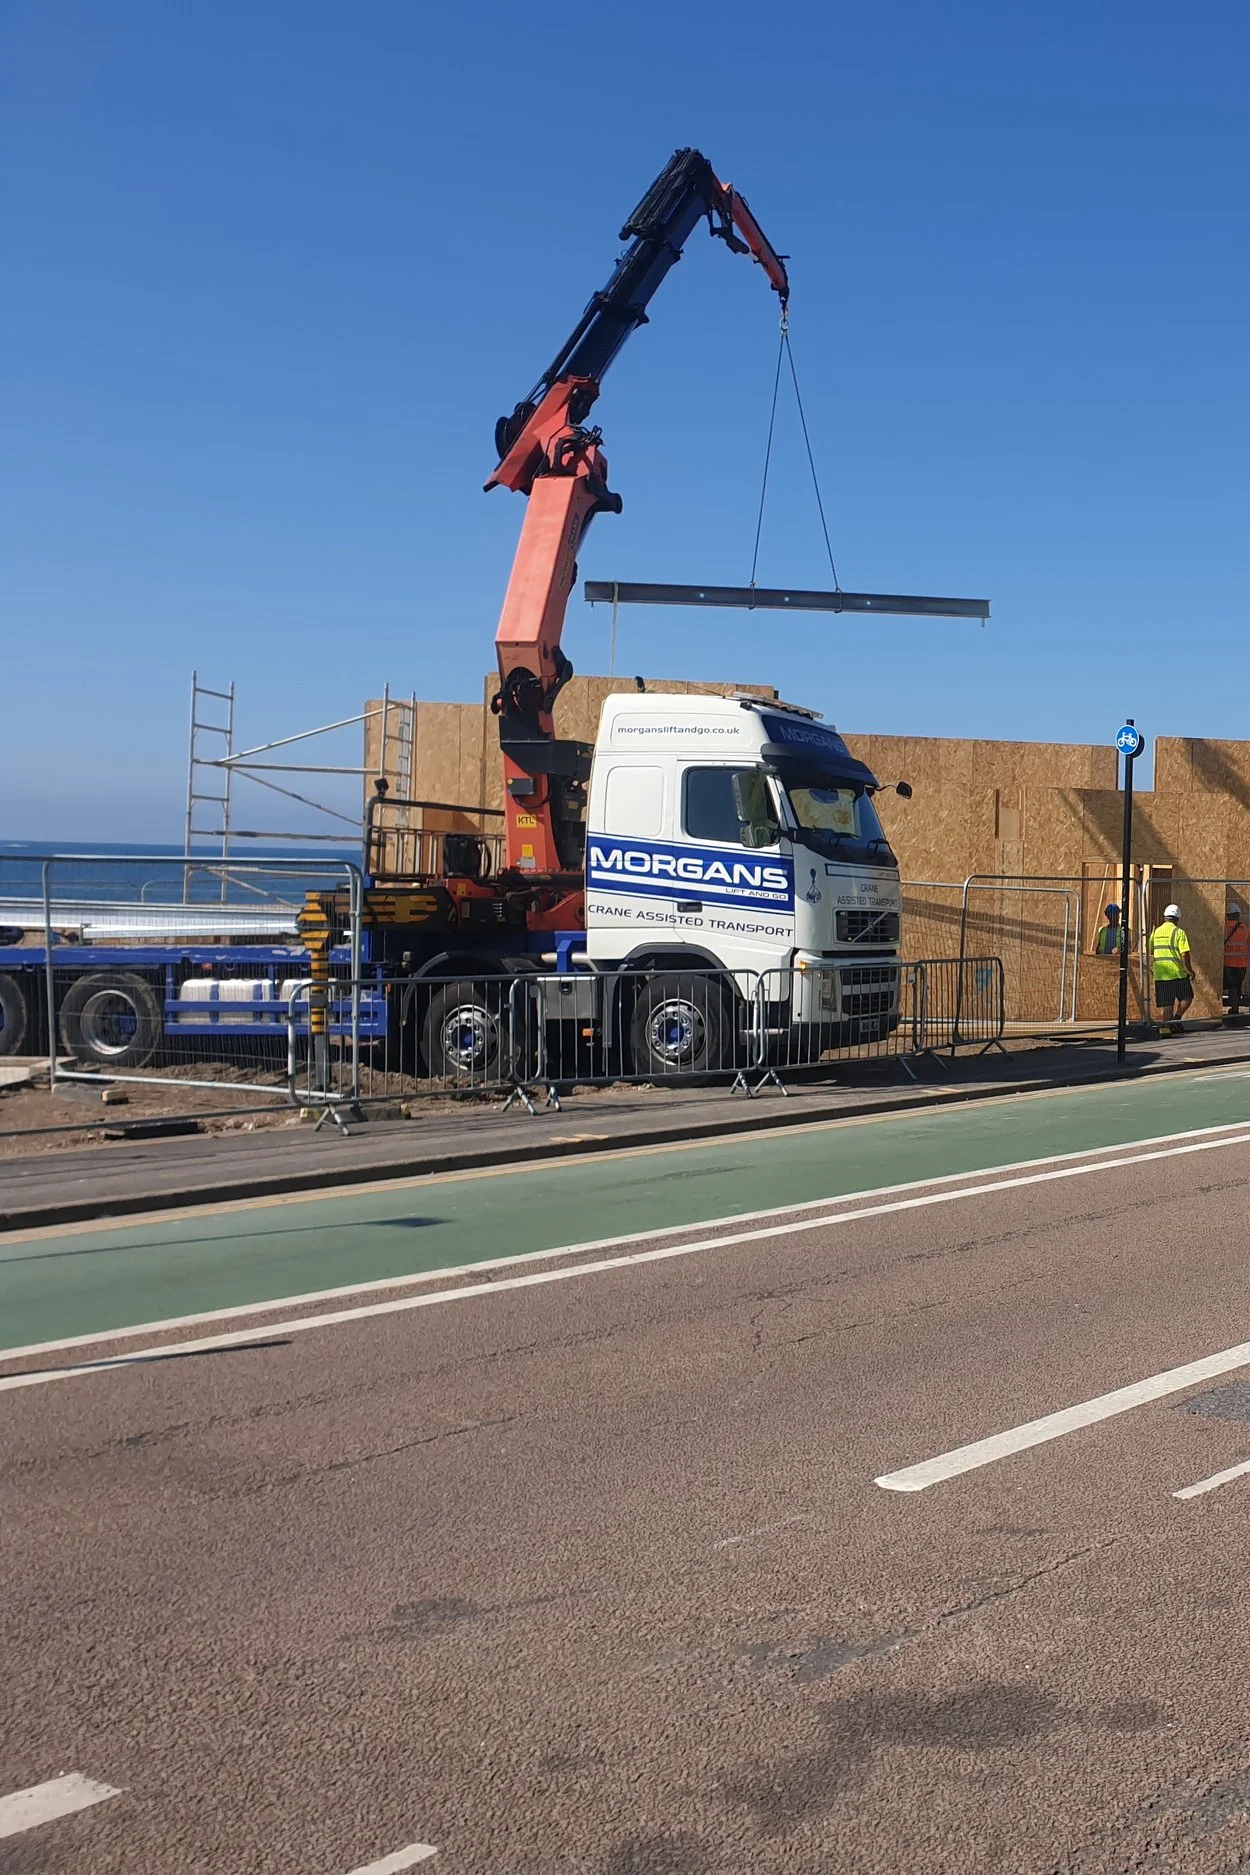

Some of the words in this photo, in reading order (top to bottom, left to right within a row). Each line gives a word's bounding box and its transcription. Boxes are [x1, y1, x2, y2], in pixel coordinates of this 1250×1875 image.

[617, 726, 740, 735] morgansliftandgo.co.uk
[779, 726, 846, 754] MORGANS
[517, 816, 535, 825] KTL
[590, 846, 788, 890] MORGANS
[725, 887, 746, 895] LIFT
[748, 890, 770, 898] AND
[860, 883, 879, 893] CRANE
[837, 895, 867, 906] ASSISTED
[588, 904, 632, 917] CRANE
[636, 910, 704, 927] ASSISTED
[708, 919, 794, 938] TRANSPORT
